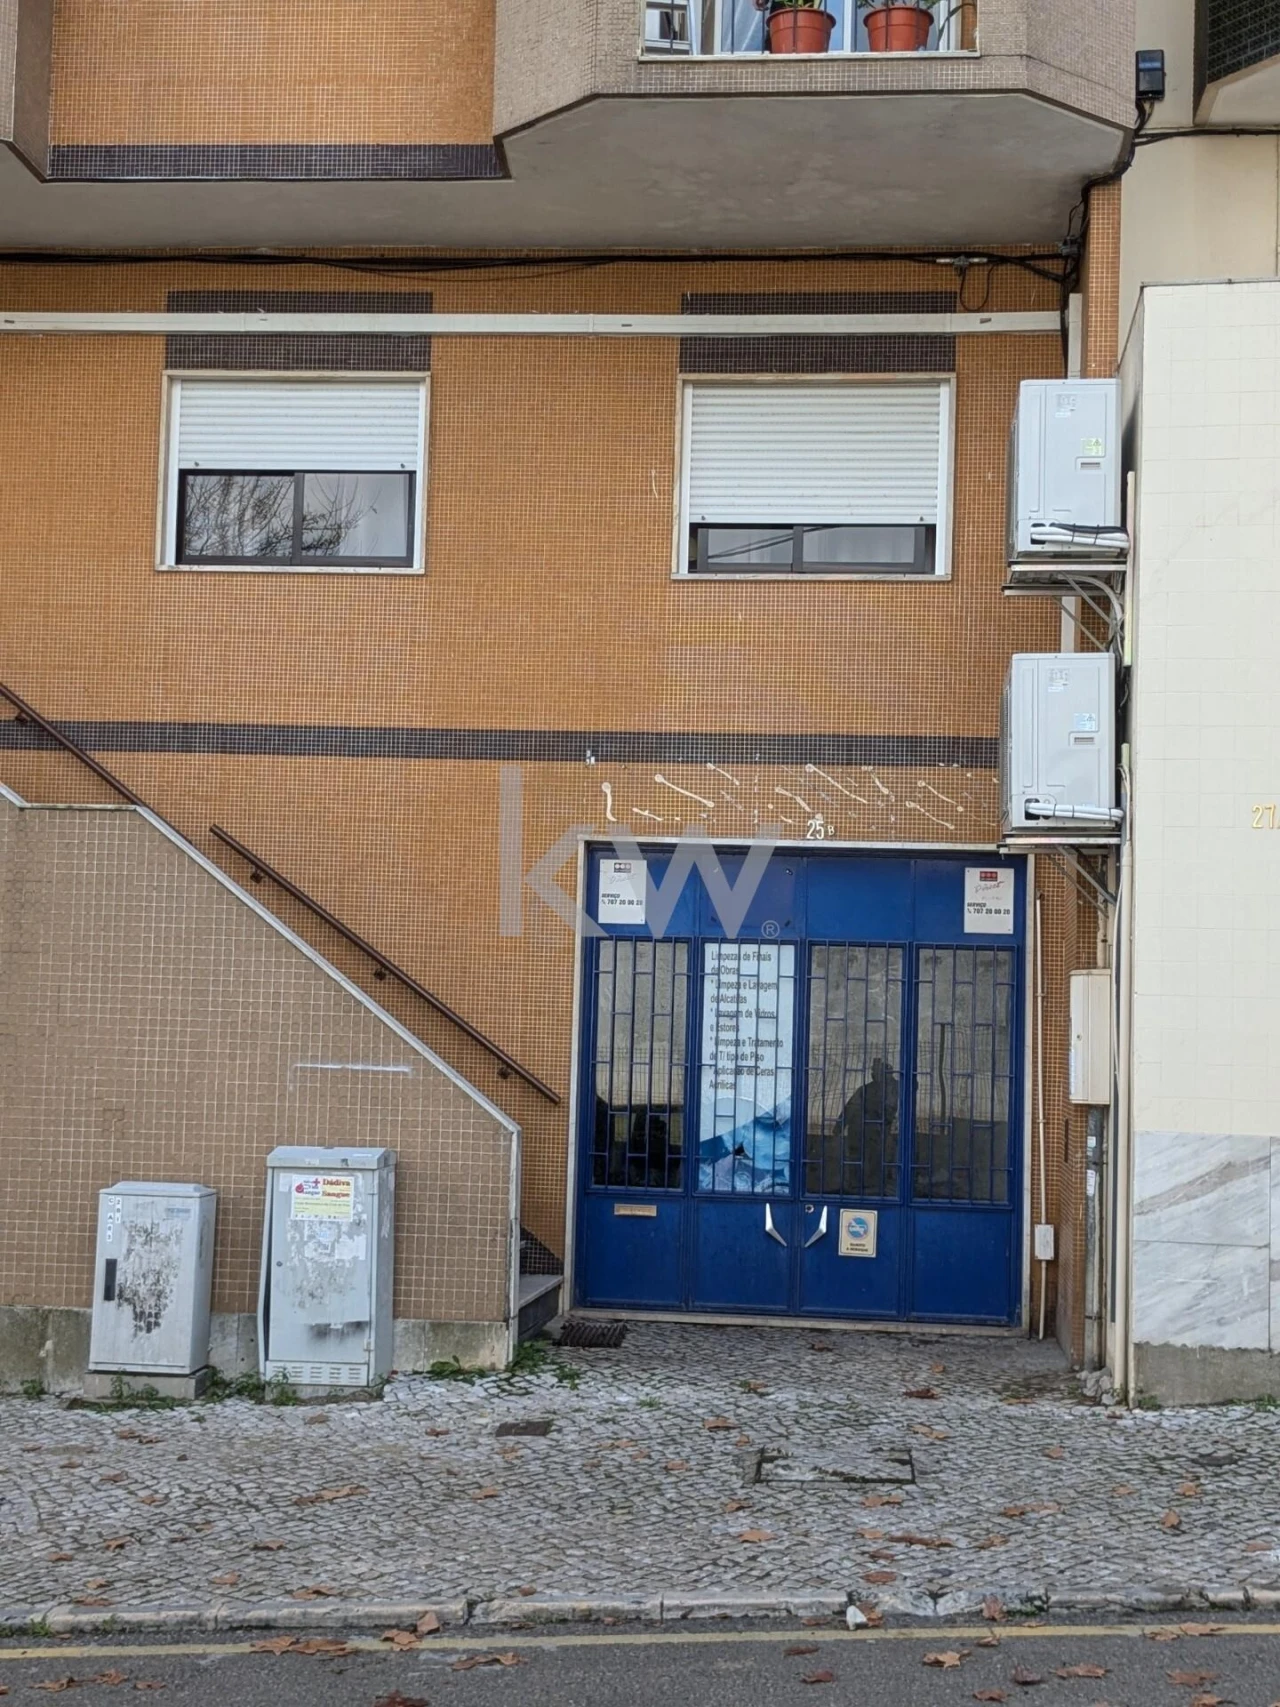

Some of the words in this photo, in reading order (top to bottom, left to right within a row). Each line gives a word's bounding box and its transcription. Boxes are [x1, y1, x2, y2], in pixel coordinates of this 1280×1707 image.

[1252, 804, 1280, 829] 27
[807, 820, 824, 839] 25
[711, 950, 741, 962] Limpeza
[742, 951, 751, 961] de
[742, 982, 747, 990] e
[719, 994, 747, 1004] Alcatas
[745, 1009, 753, 1018] de
[742, 1039, 746, 1047] e
[740, 1052, 749, 1061] de
[750, 1052, 765, 1062] Pso
[746, 1066, 754, 1076] de
